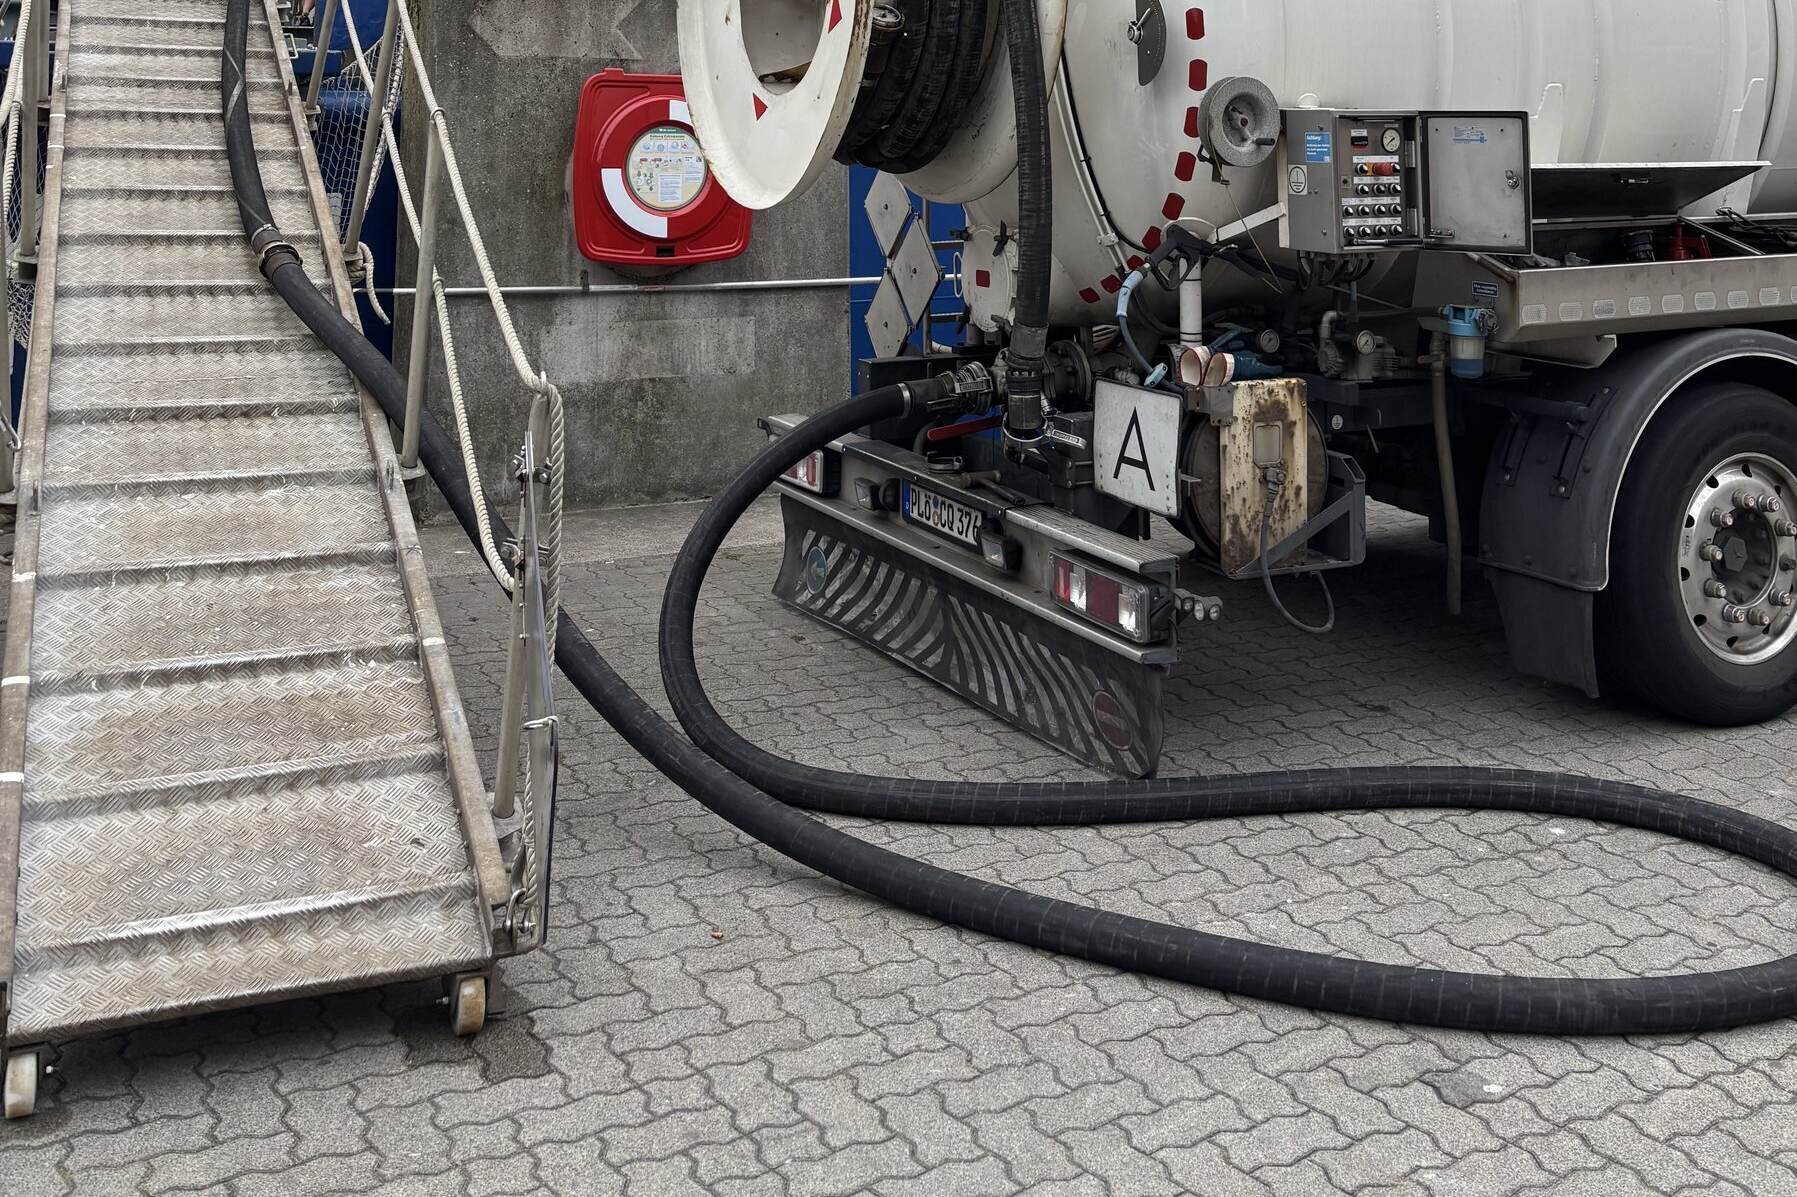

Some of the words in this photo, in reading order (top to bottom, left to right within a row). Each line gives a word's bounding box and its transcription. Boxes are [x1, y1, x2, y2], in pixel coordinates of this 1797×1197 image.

[1112, 405, 1156, 492] A
[910, 486, 932, 522] PLÖ
[939, 499, 955, 532] CQ
